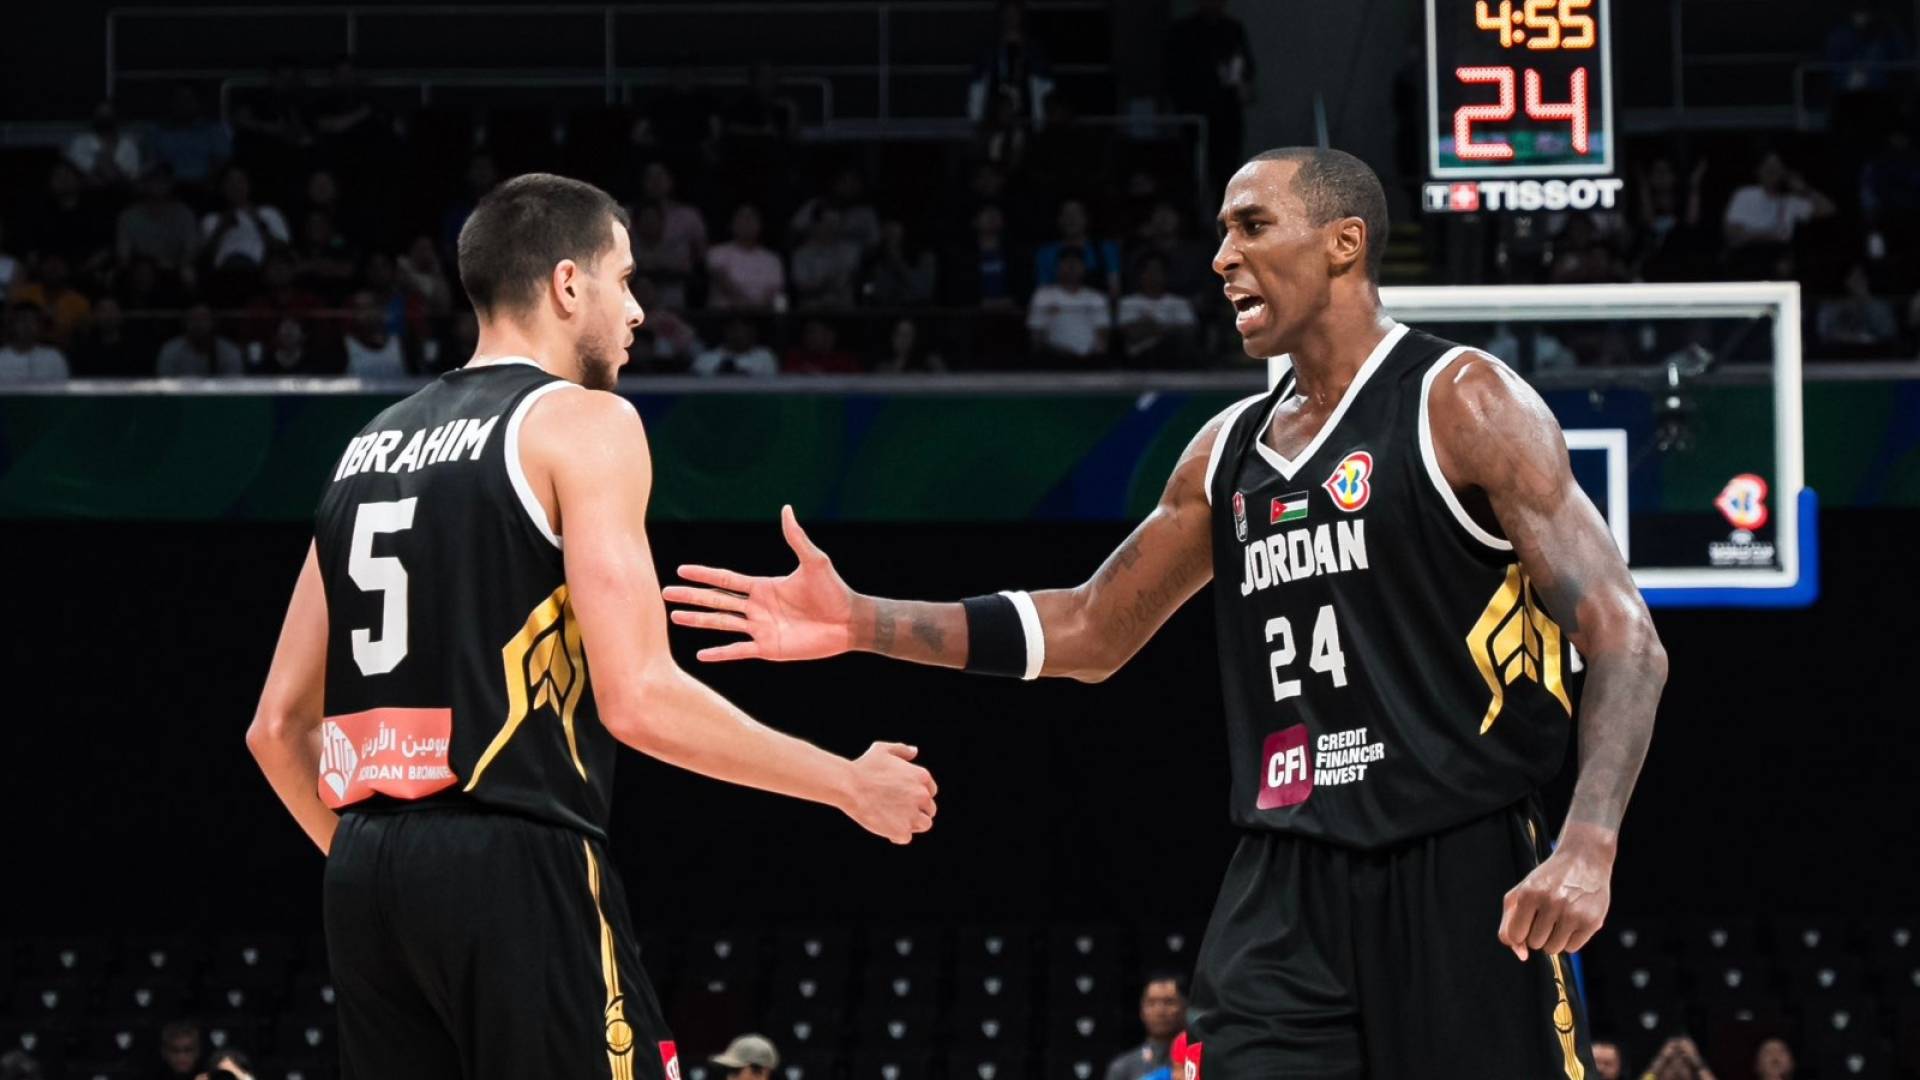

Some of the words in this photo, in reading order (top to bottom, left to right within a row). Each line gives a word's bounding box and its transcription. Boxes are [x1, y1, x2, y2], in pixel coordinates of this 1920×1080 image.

[1475, 0, 1595, 48] 4:55
[1454, 66, 1589, 159] 24
[1479, 178, 1624, 211] TISSOT
[334, 415, 500, 482] IBRAHIM
[1241, 519, 1369, 597] JORDAN
[348, 497, 418, 677] 5
[1265, 605, 1348, 702] 24
[1267, 745, 1308, 788] CFI
[1317, 727, 1368, 751] CREDIT
[1313, 764, 1368, 786] INVEST
